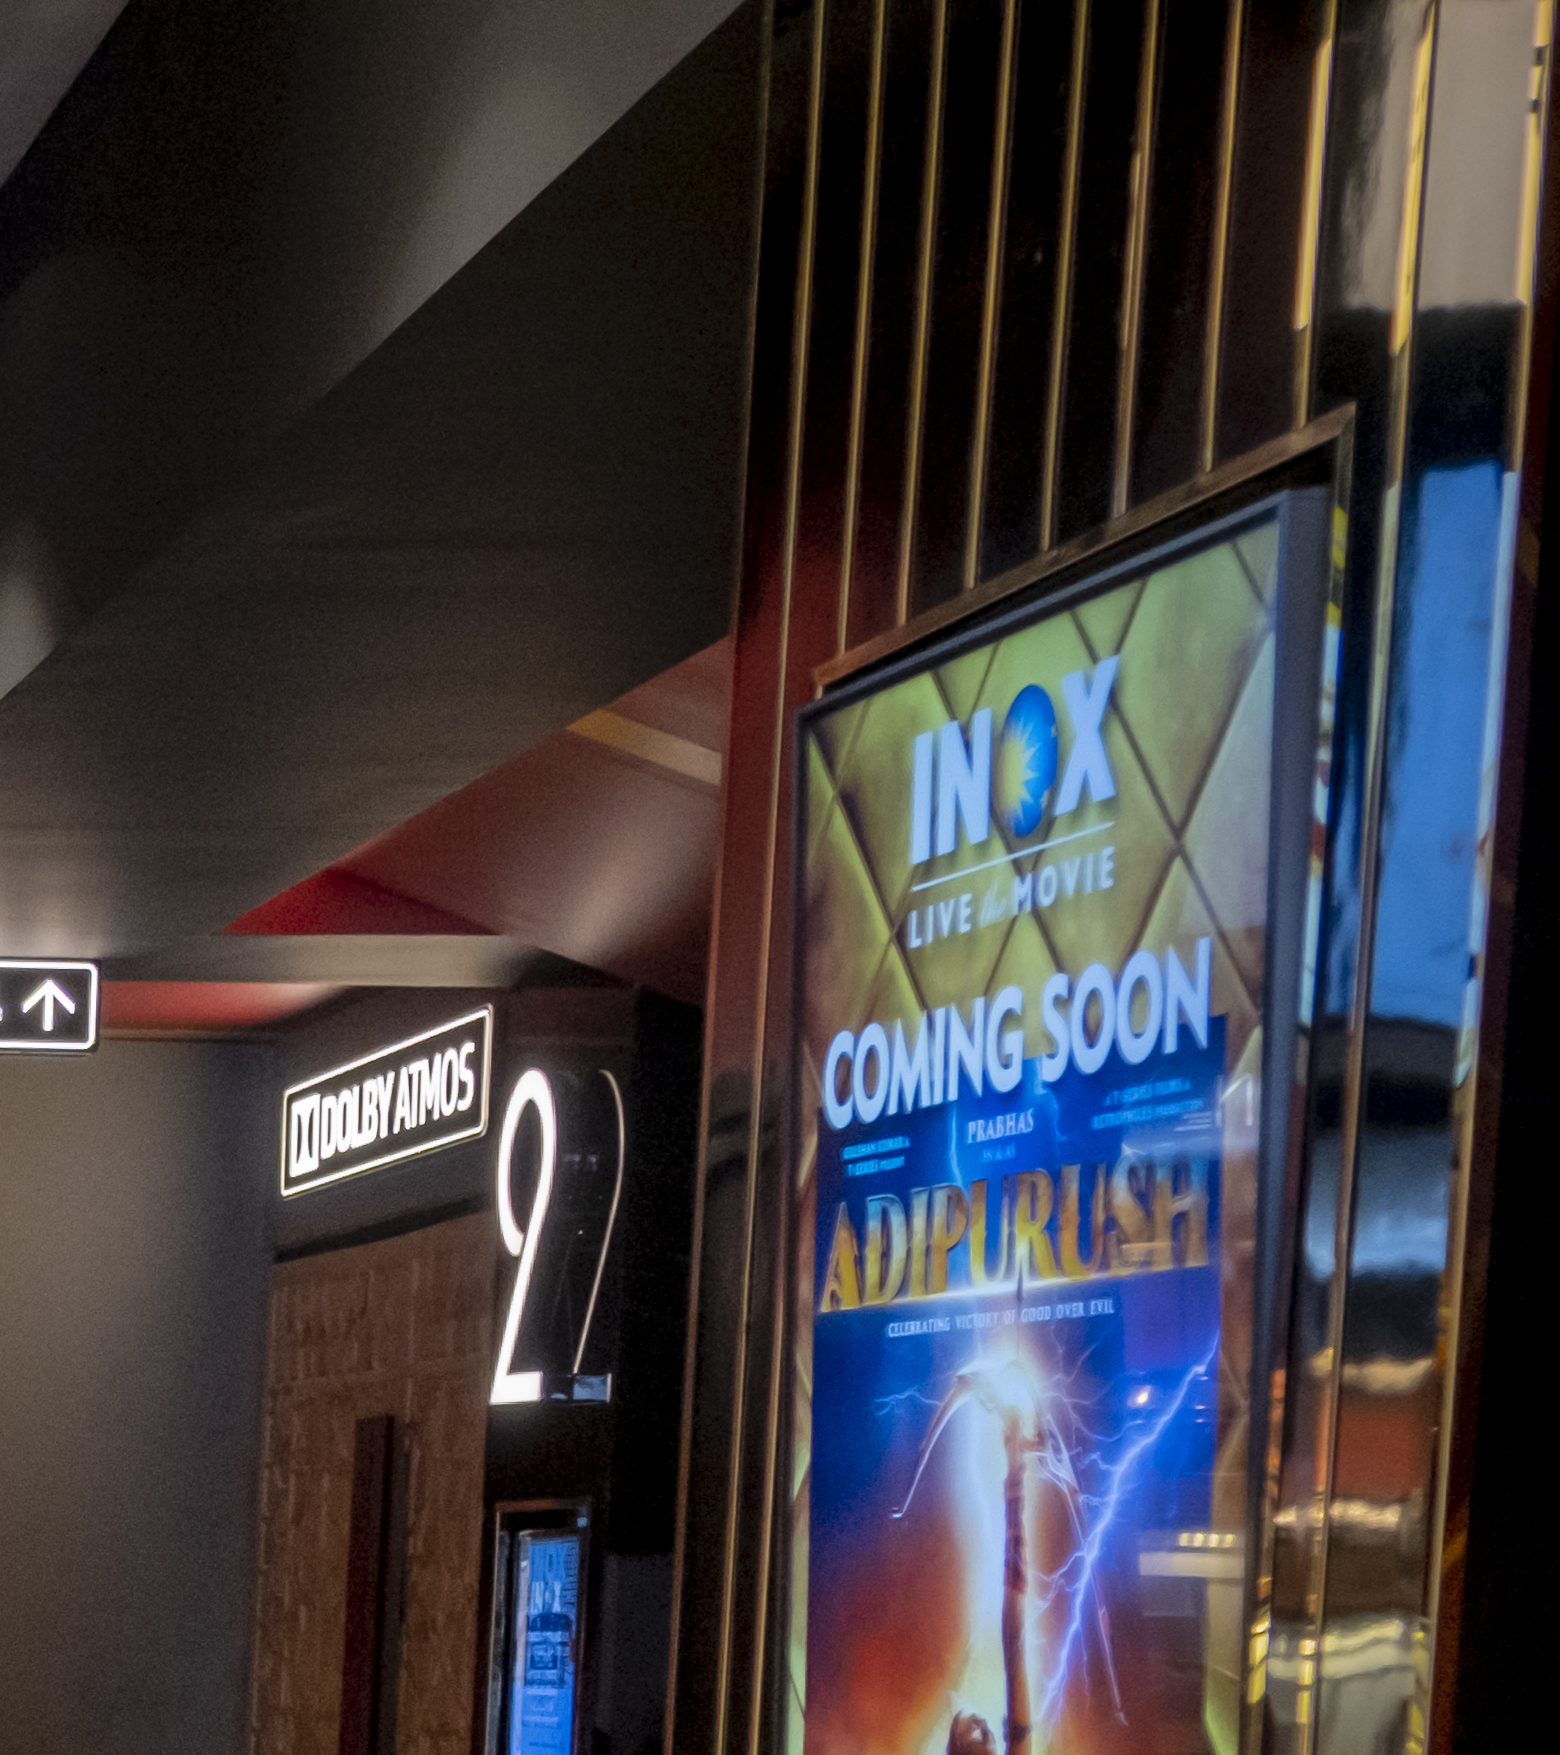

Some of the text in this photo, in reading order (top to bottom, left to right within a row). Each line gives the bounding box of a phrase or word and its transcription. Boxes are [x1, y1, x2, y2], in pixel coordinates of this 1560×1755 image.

[910, 655, 1120, 865] INOX
[906, 845, 1116, 949] LIVE MOVIE
[319, 1041, 476, 1160] DOLBY ATMOS
[823, 937, 1213, 1130] COMING SOON
[967, 1108, 1034, 1144] PRABHAS
[488, 1067, 558, 1406] 2
[820, 1158, 1209, 1312] ADIPURUSH
[887, 1298, 1116, 1338] CELEBRATING VICTORY OF GOOD OVER EVIL
